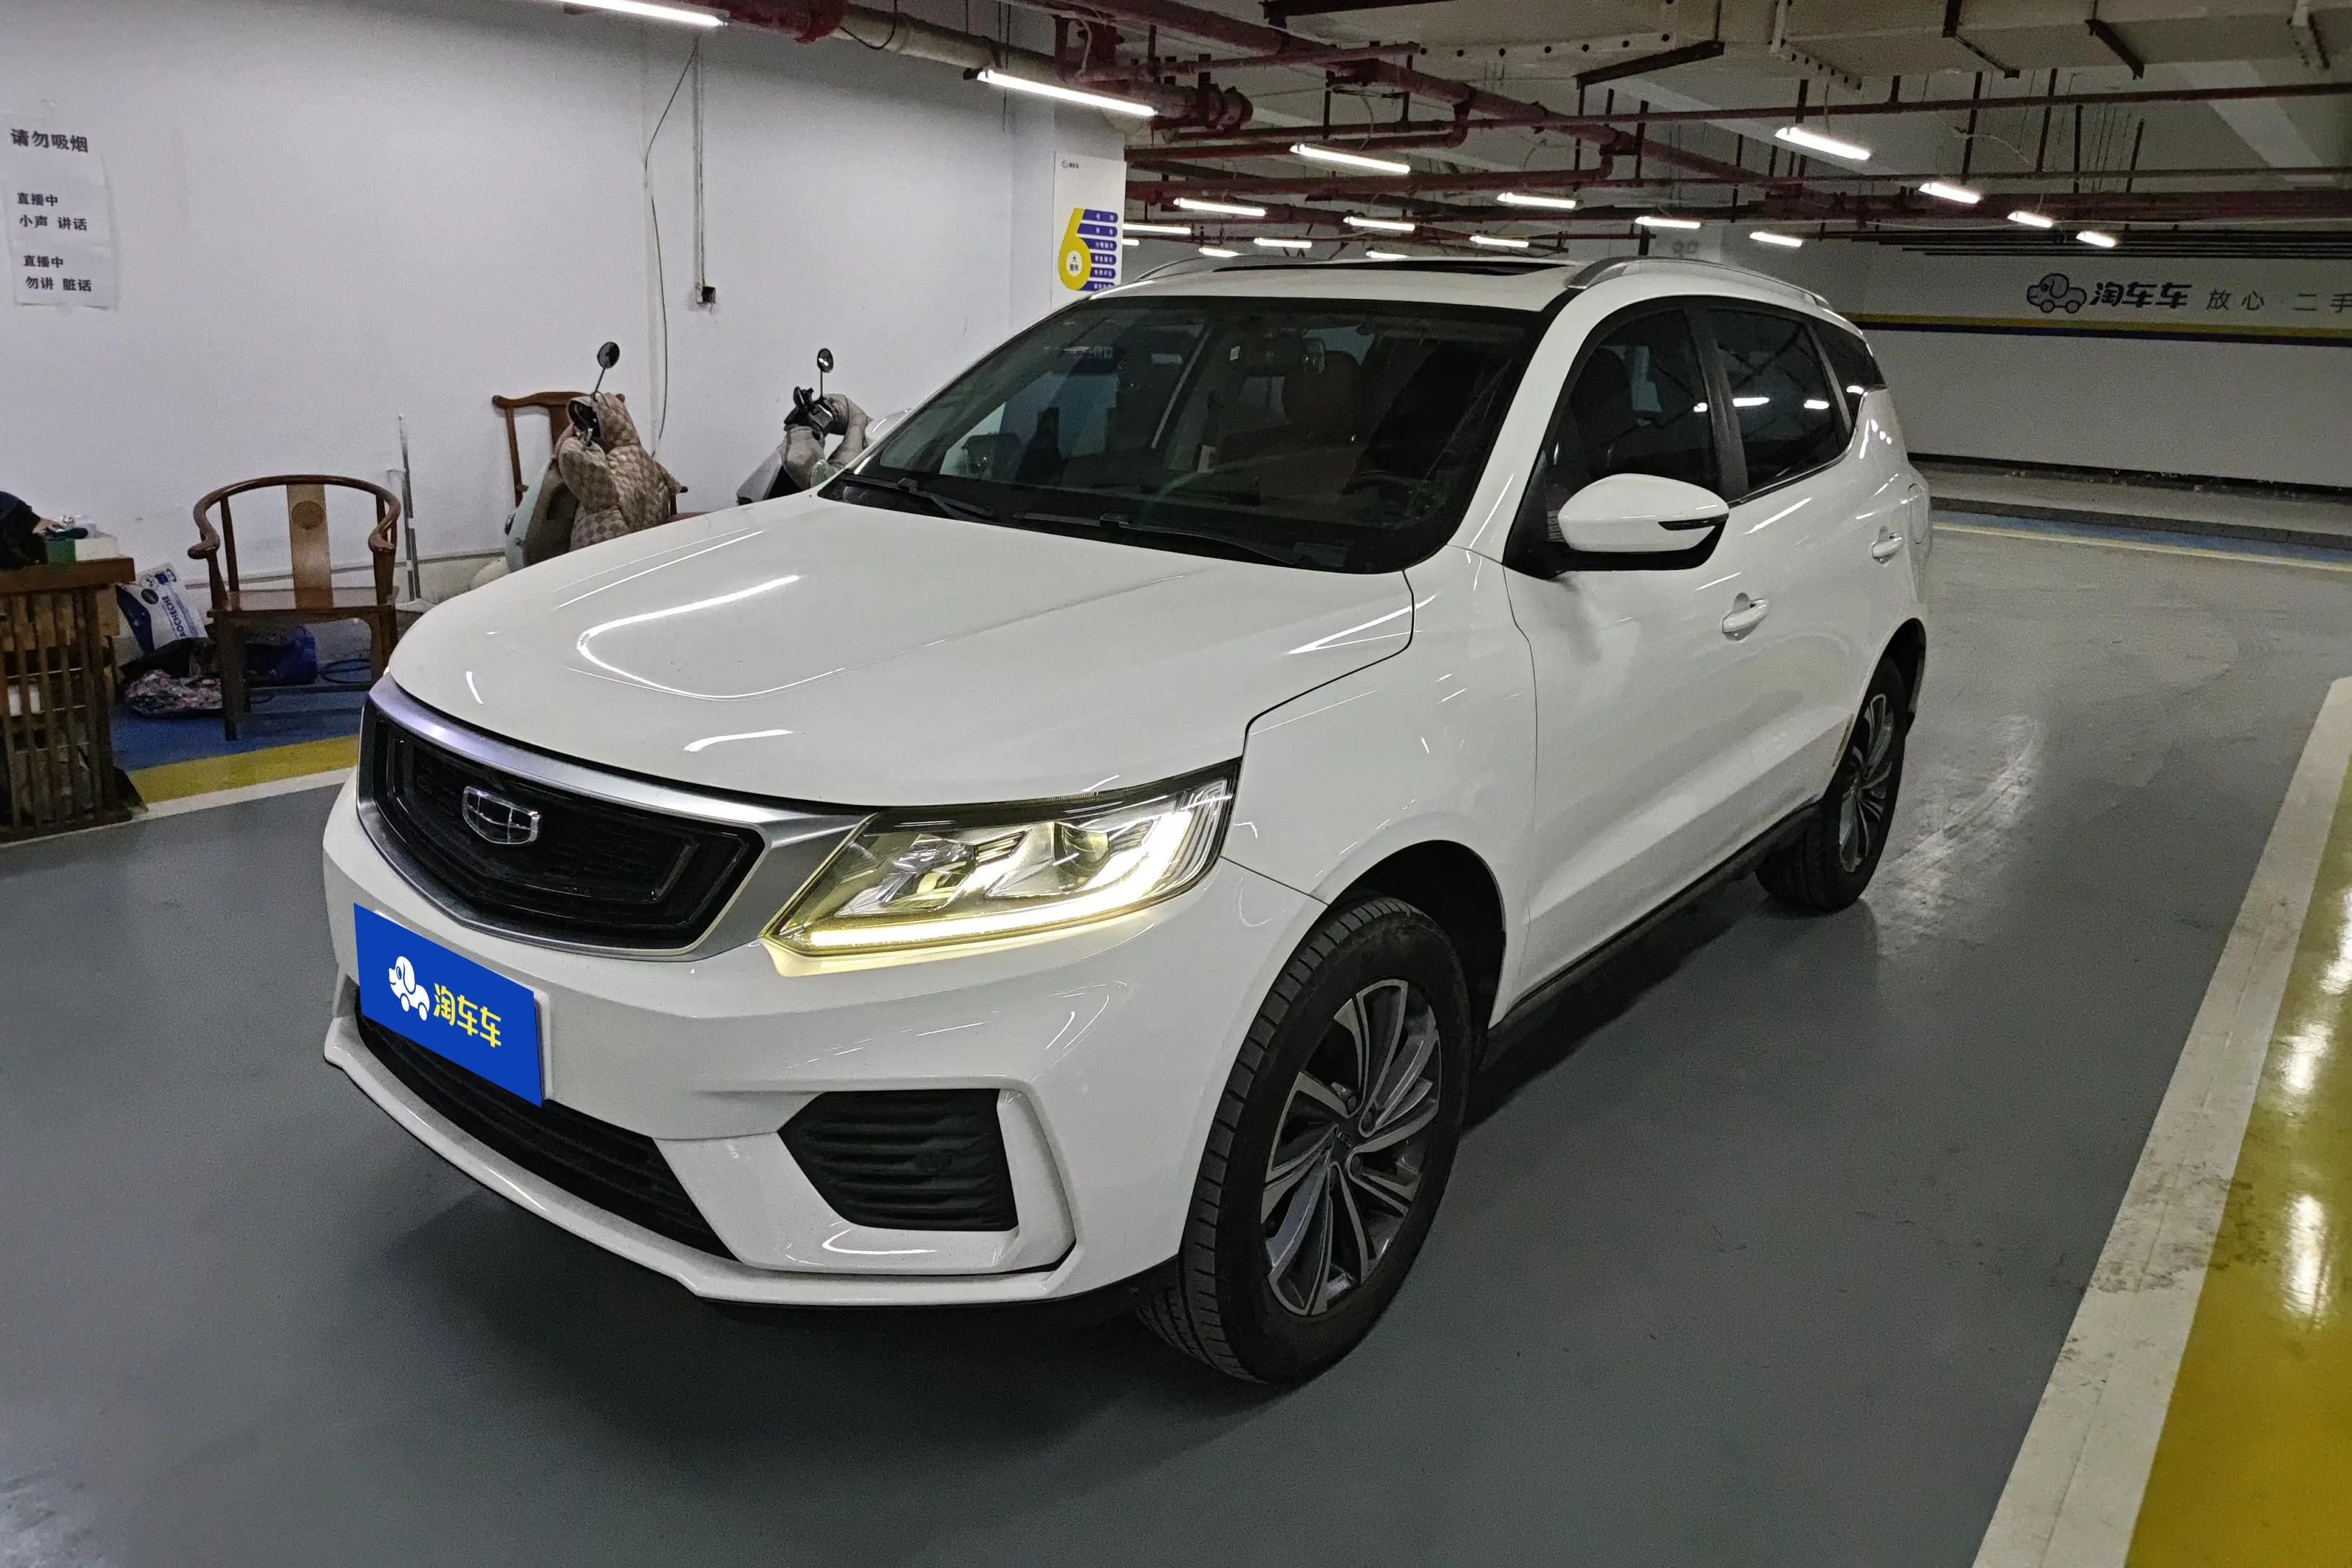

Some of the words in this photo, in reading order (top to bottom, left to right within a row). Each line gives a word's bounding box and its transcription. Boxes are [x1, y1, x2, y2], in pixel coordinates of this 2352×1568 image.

[10, 128, 89, 153] 请勿吸烟
[17, 192, 58, 207] 直播中
[19, 215, 48, 228] 小声
[58, 216, 87, 231] 讲话
[23, 255, 64, 269] 直播中
[26, 276, 54, 290] 勿讲
[63, 278, 92, 292] 脏话
[2090, 281, 2192, 309] 淘车车
[2206, 288, 2265, 311] 放心
